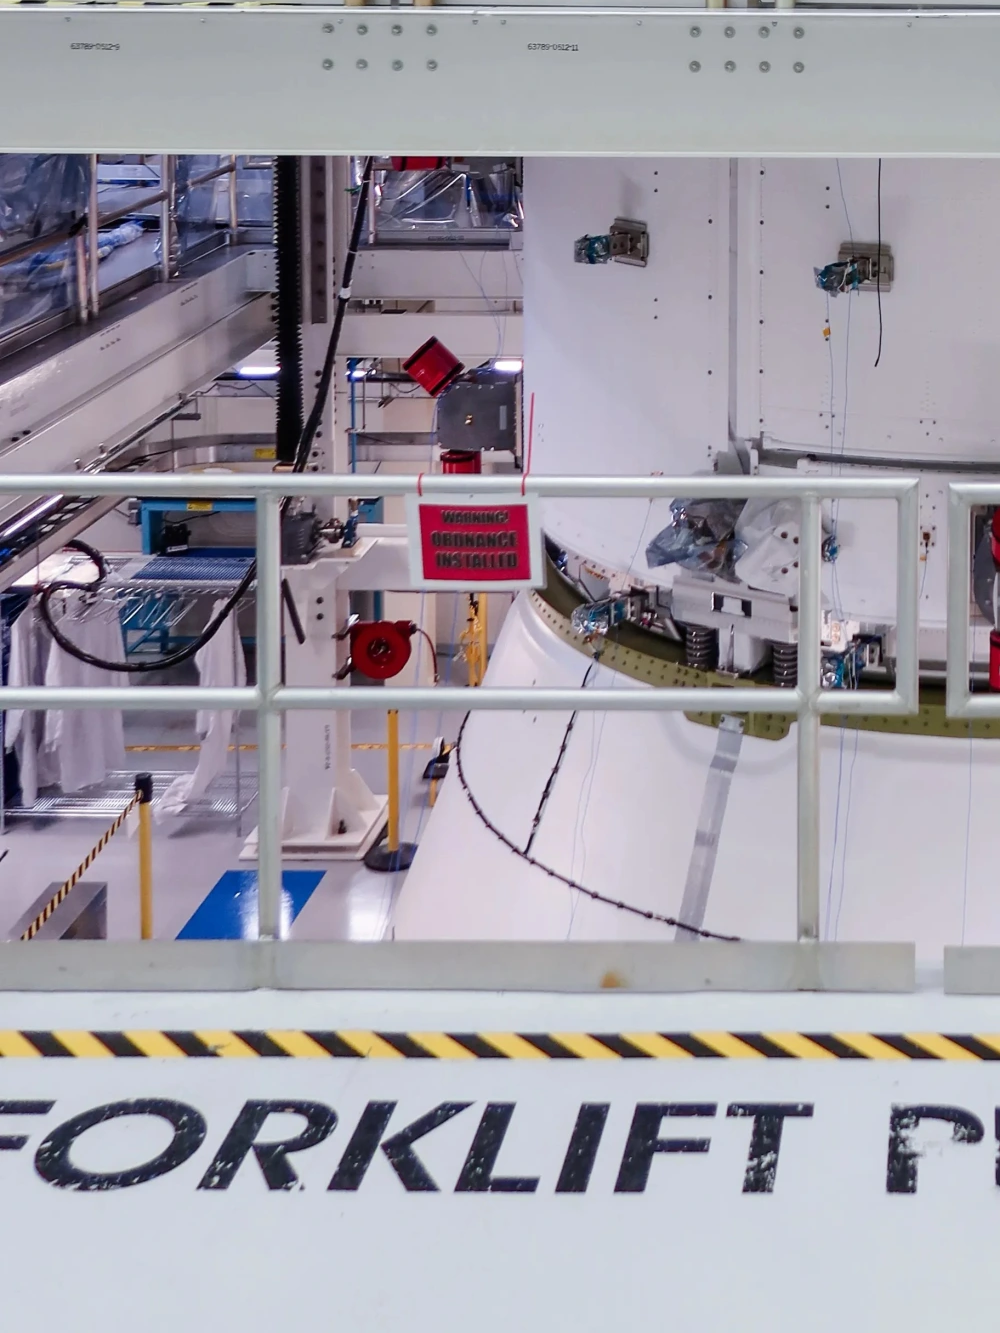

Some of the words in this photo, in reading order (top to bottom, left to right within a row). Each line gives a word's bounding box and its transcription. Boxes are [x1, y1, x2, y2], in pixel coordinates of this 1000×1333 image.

[441, 510, 509, 524] WARNING!
[431, 531, 517, 548] ORDNANCE
[435, 551, 518, 569] INSTALLED
